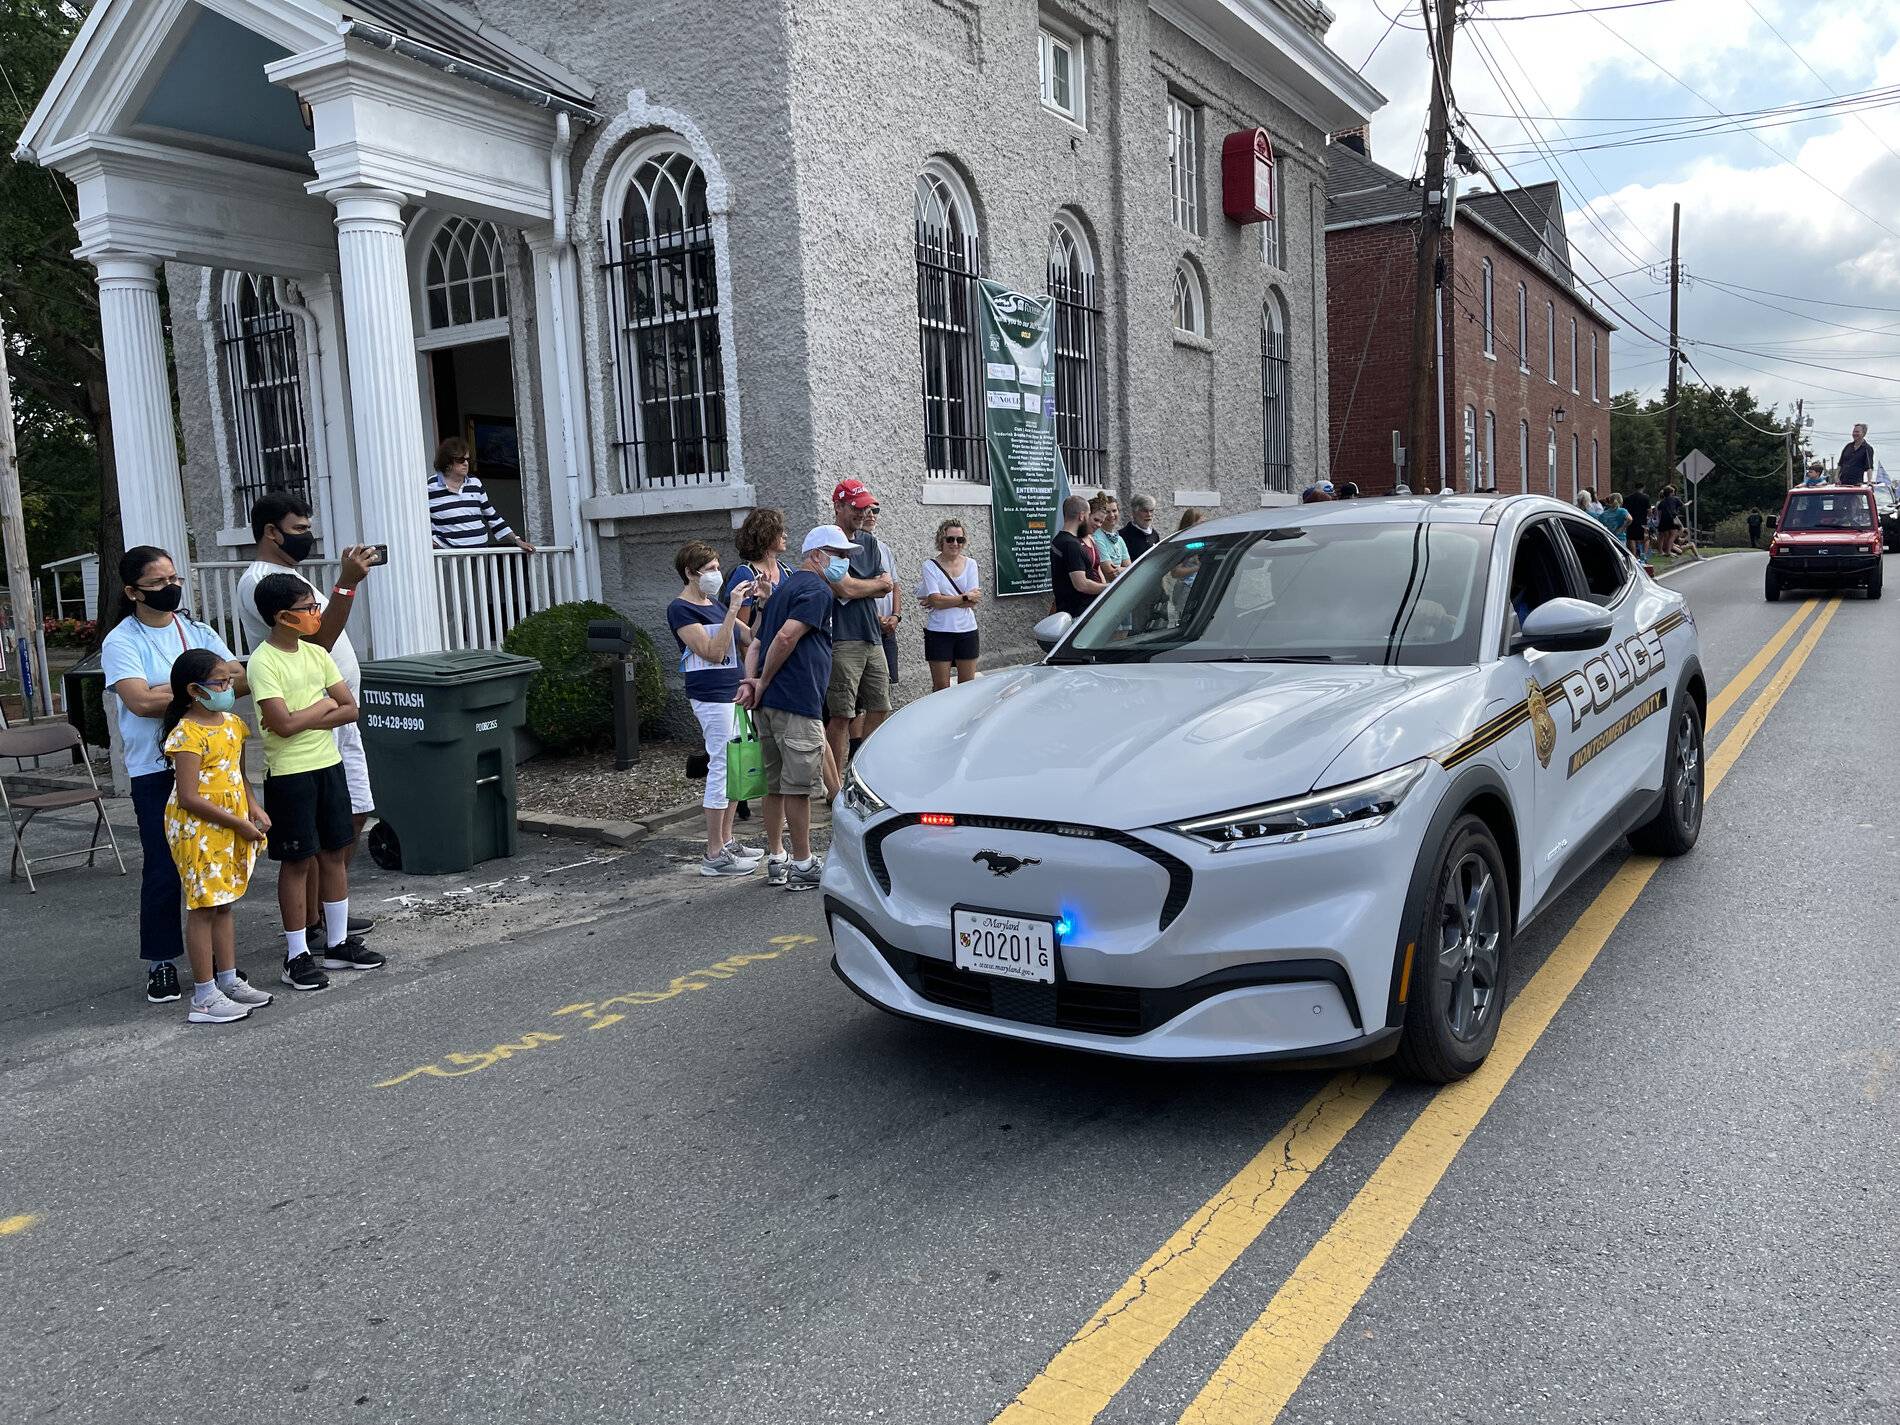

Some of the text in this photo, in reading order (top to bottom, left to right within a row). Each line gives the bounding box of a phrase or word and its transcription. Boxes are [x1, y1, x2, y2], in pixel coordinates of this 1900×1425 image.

[1560, 628, 1665, 733] POLICE
[363, 689, 425, 708] TITUS TRASH
[367, 714, 425, 731] 301-428-8990
[1572, 692, 1661, 773] MONTGOMERY COUNTY
[983, 917, 1020, 932] Maryland
[972, 929, 1031, 965] 20201
